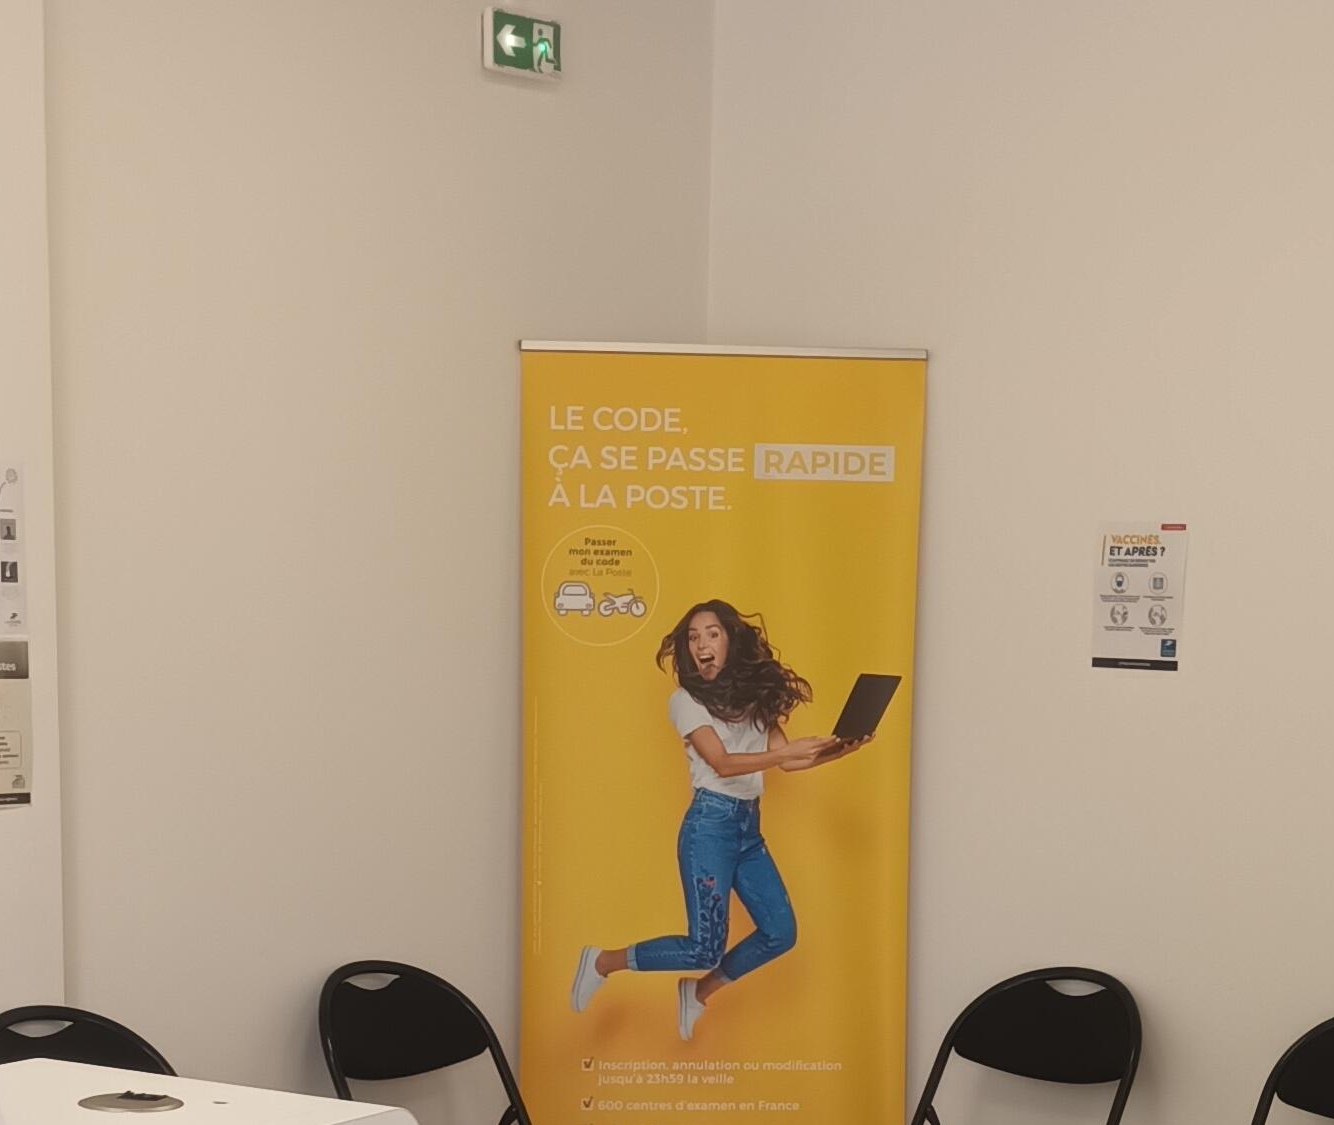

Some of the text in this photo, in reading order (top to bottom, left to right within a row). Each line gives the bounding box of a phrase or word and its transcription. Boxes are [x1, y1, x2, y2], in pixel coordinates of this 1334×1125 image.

[550, 405, 688, 434] LE CODE,
[548, 445, 888, 477] ÇA SE PASSE RAPIDE
[548, 475, 732, 511] À LA POSTE.
[584, 537, 617, 547] Passer
[569, 548, 591, 556] mon
[1109, 546, 1123, 556] ET
[581, 557, 621, 566] du code
[672, 1060, 740, 1071] annulation
[743, 1062, 760, 1071] ou
[763, 1059, 842, 1071] modification
[687, 1074, 698, 1084] la
[701, 1074, 734, 1084] veille
[626, 1101, 672, 1111] centres
[676, 1100, 736, 1111] d'examen
[739, 1102, 754, 1111] en
[758, 1100, 800, 1111] France
